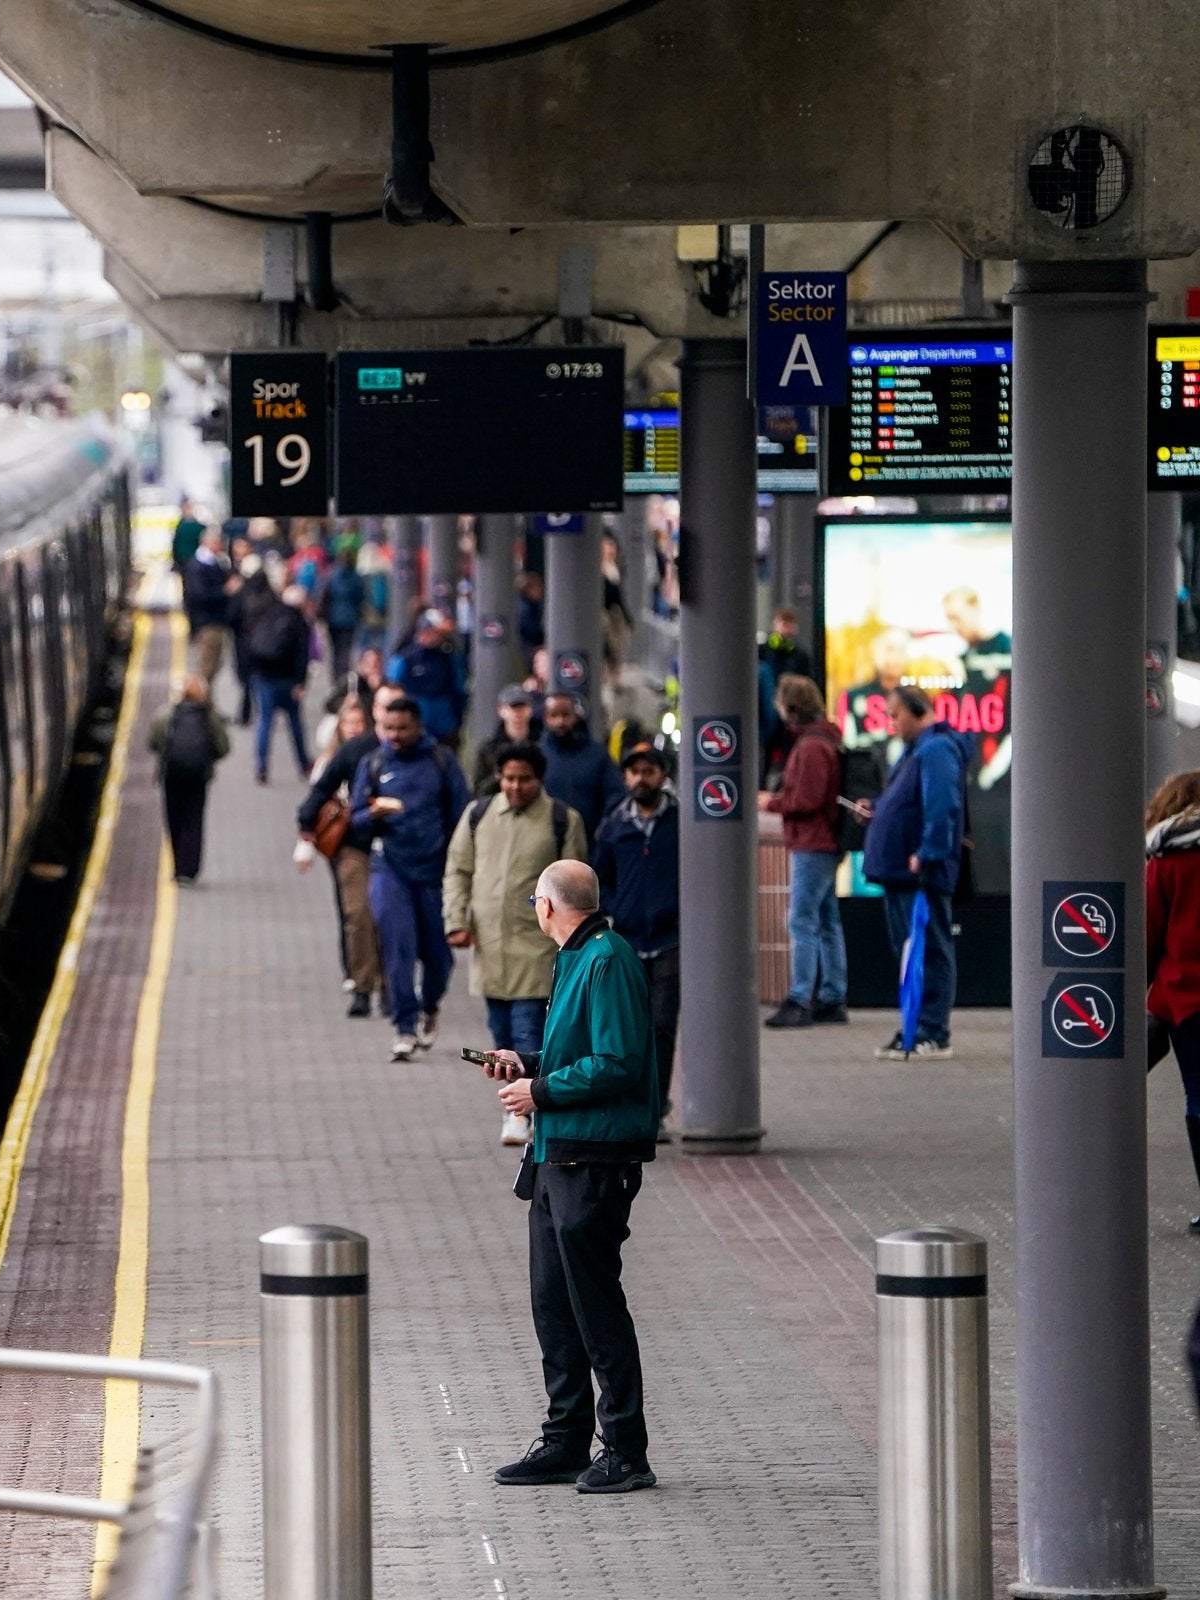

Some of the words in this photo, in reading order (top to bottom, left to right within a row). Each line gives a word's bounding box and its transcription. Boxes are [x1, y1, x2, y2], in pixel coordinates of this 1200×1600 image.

[768, 279, 836, 300] Sektor
[768, 302, 836, 321] Sector
[779, 333, 824, 387] A
[869, 348, 918, 363] Avganger
[920, 347, 977, 361] Departures
[561, 362, 603, 379] 17:33
[252, 378, 300, 401] Spor
[252, 399, 308, 419] Track
[244, 433, 311, 487] 19
[864, 693, 1004, 733] SDAG
